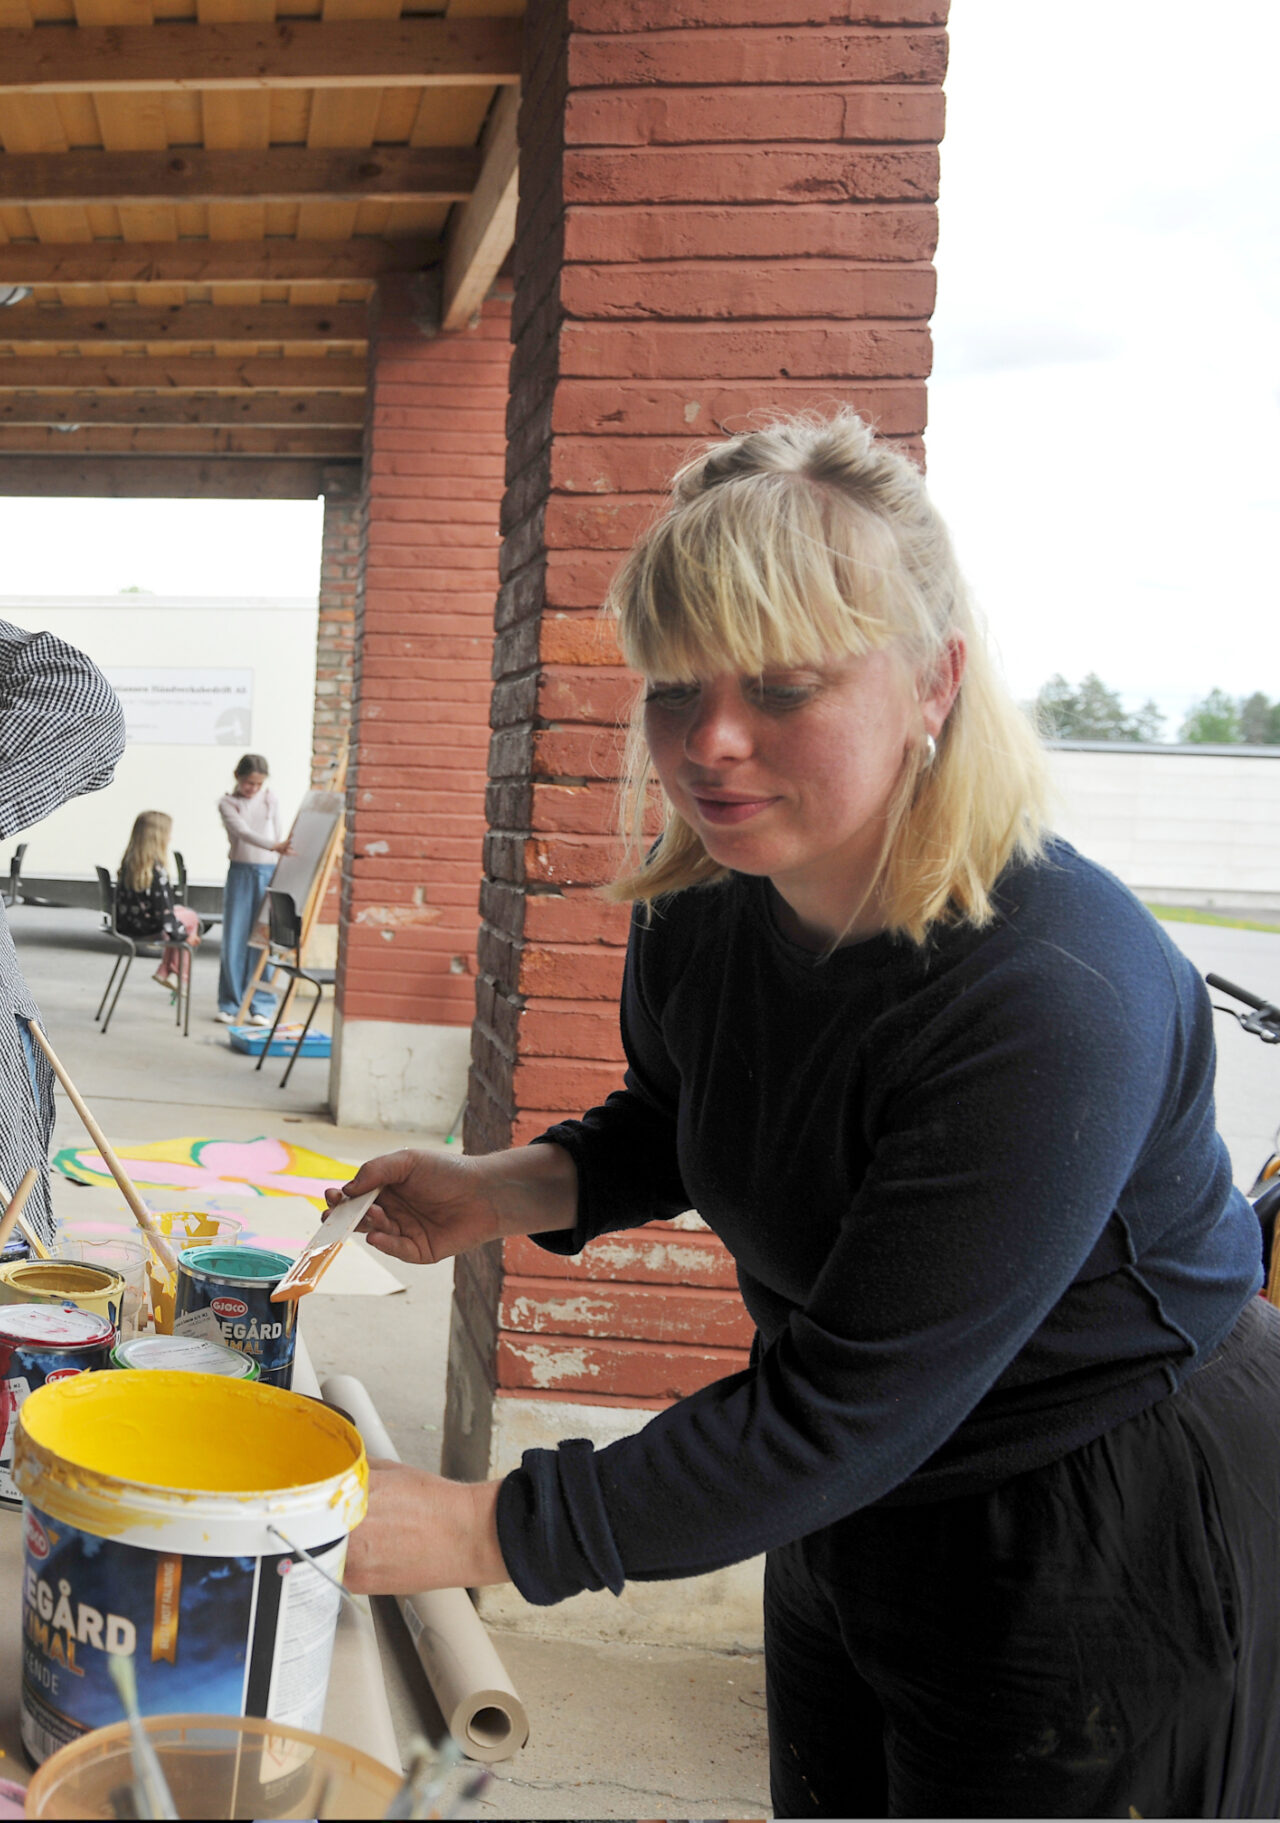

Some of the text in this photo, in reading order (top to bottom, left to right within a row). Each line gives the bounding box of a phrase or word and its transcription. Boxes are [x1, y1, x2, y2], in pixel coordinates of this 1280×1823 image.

[212, 1300, 245, 1313] GJØCO
[221, 1317, 282, 1340] EGÅRD
[25, 1566, 137, 1657] EGÅRD
